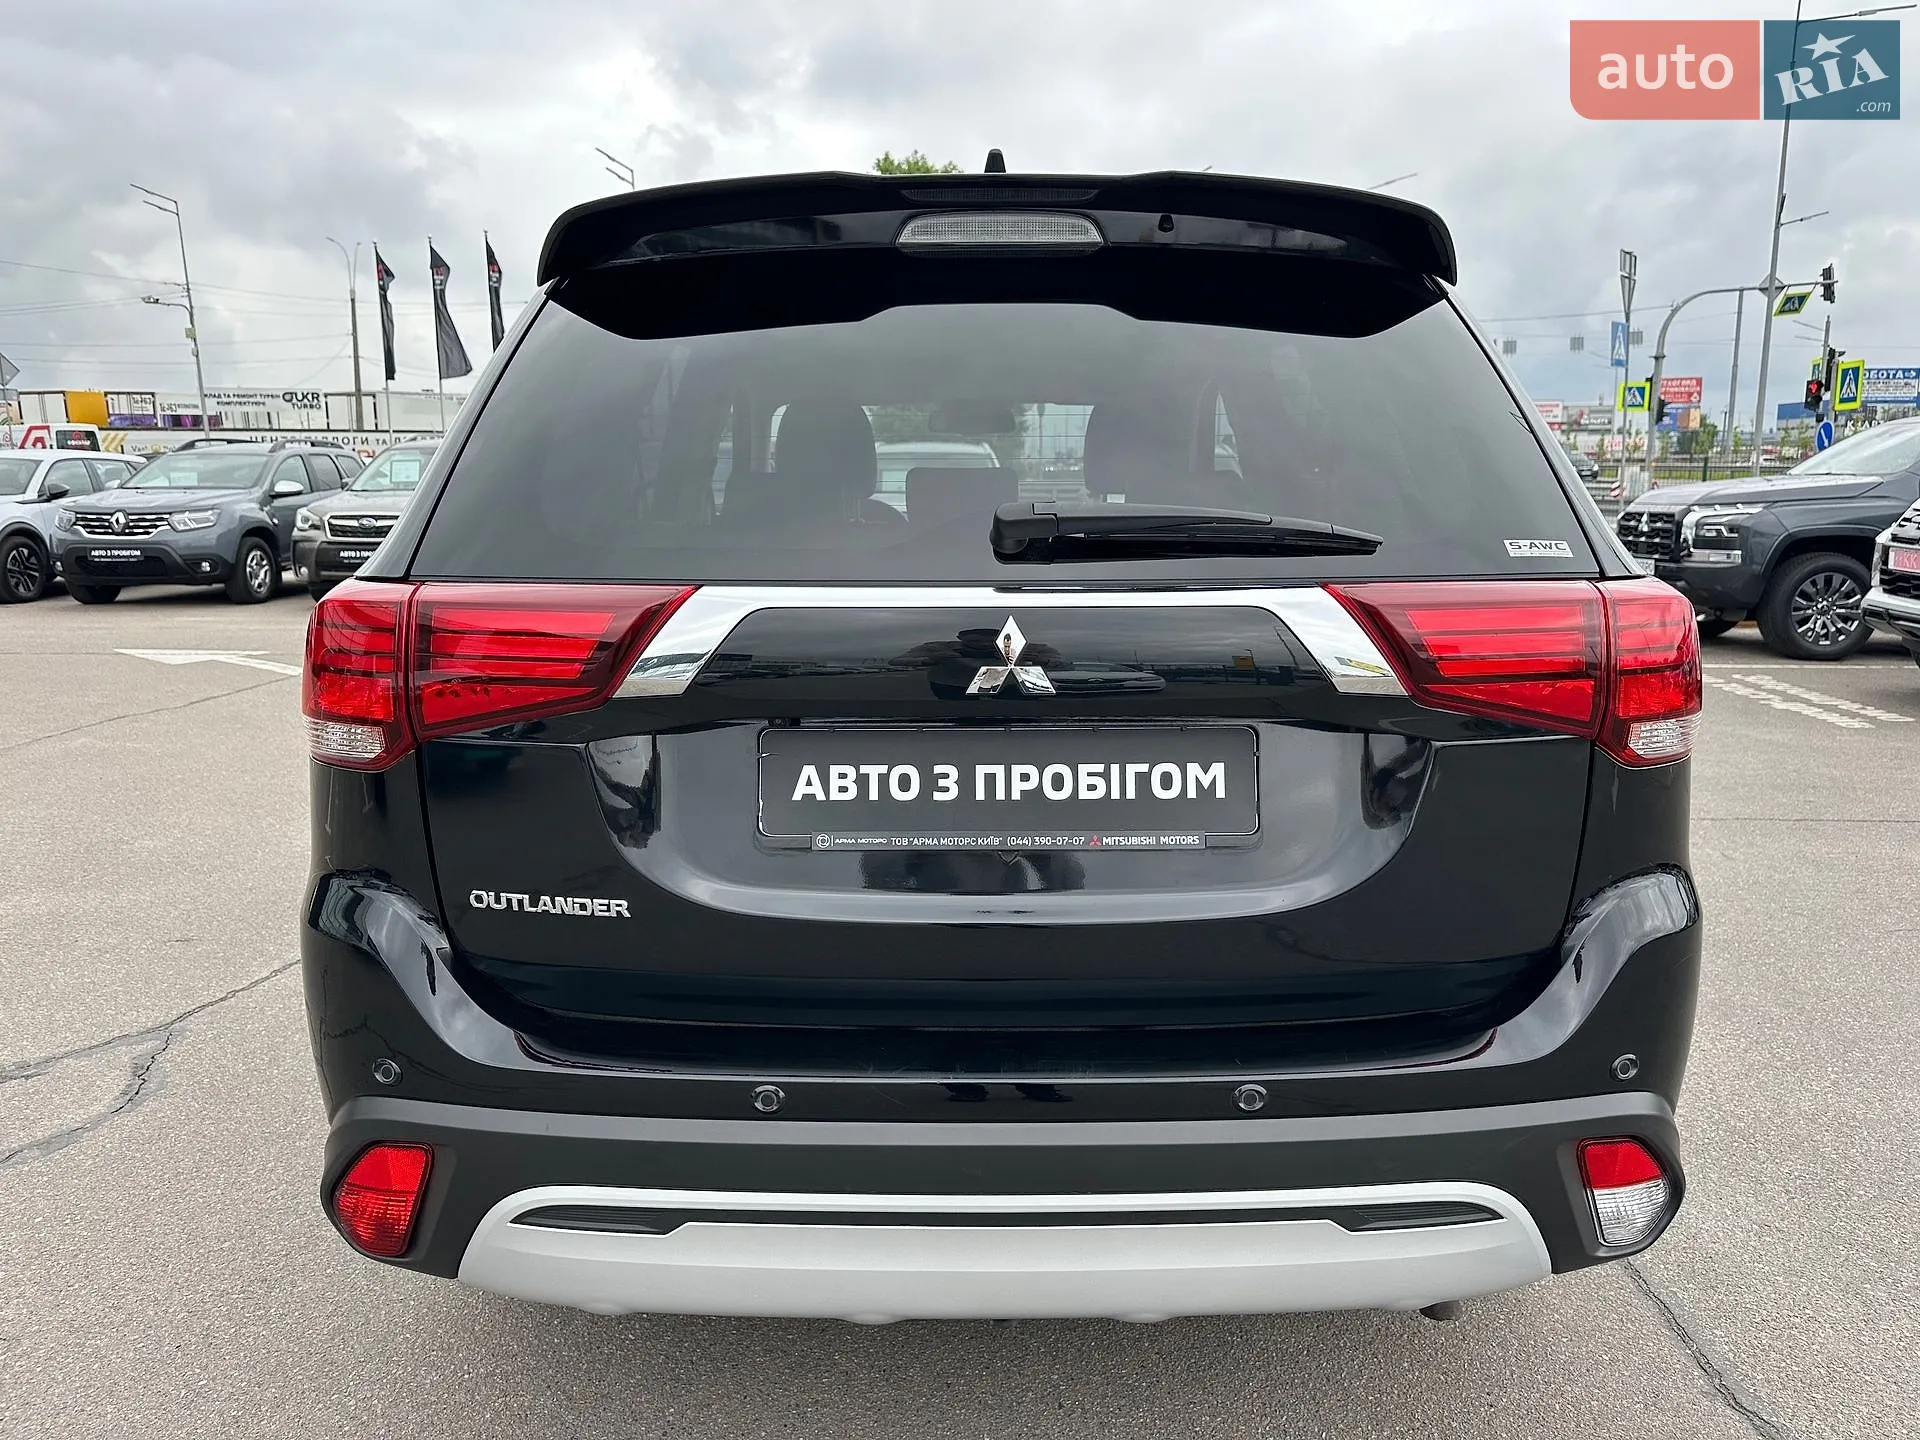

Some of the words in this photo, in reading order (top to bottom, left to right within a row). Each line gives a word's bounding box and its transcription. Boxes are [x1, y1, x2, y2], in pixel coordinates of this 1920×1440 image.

[1508, 541, 1567, 551] S-AWC
[791, 764, 921, 801] АВТО
[975, 762, 1226, 800] ПРОБІГОМ
[891, 837, 908, 846] ТОВ
[940, 837, 977, 846] МОТОРС
[1007, 836, 1032, 847] (044)
[1033, 836, 1085, 846] 390-07-07
[1102, 837, 1156, 846] MITSUBISHI
[1160, 836, 1200, 845] MOTORS
[469, 889, 632, 918] OUTLANDER
